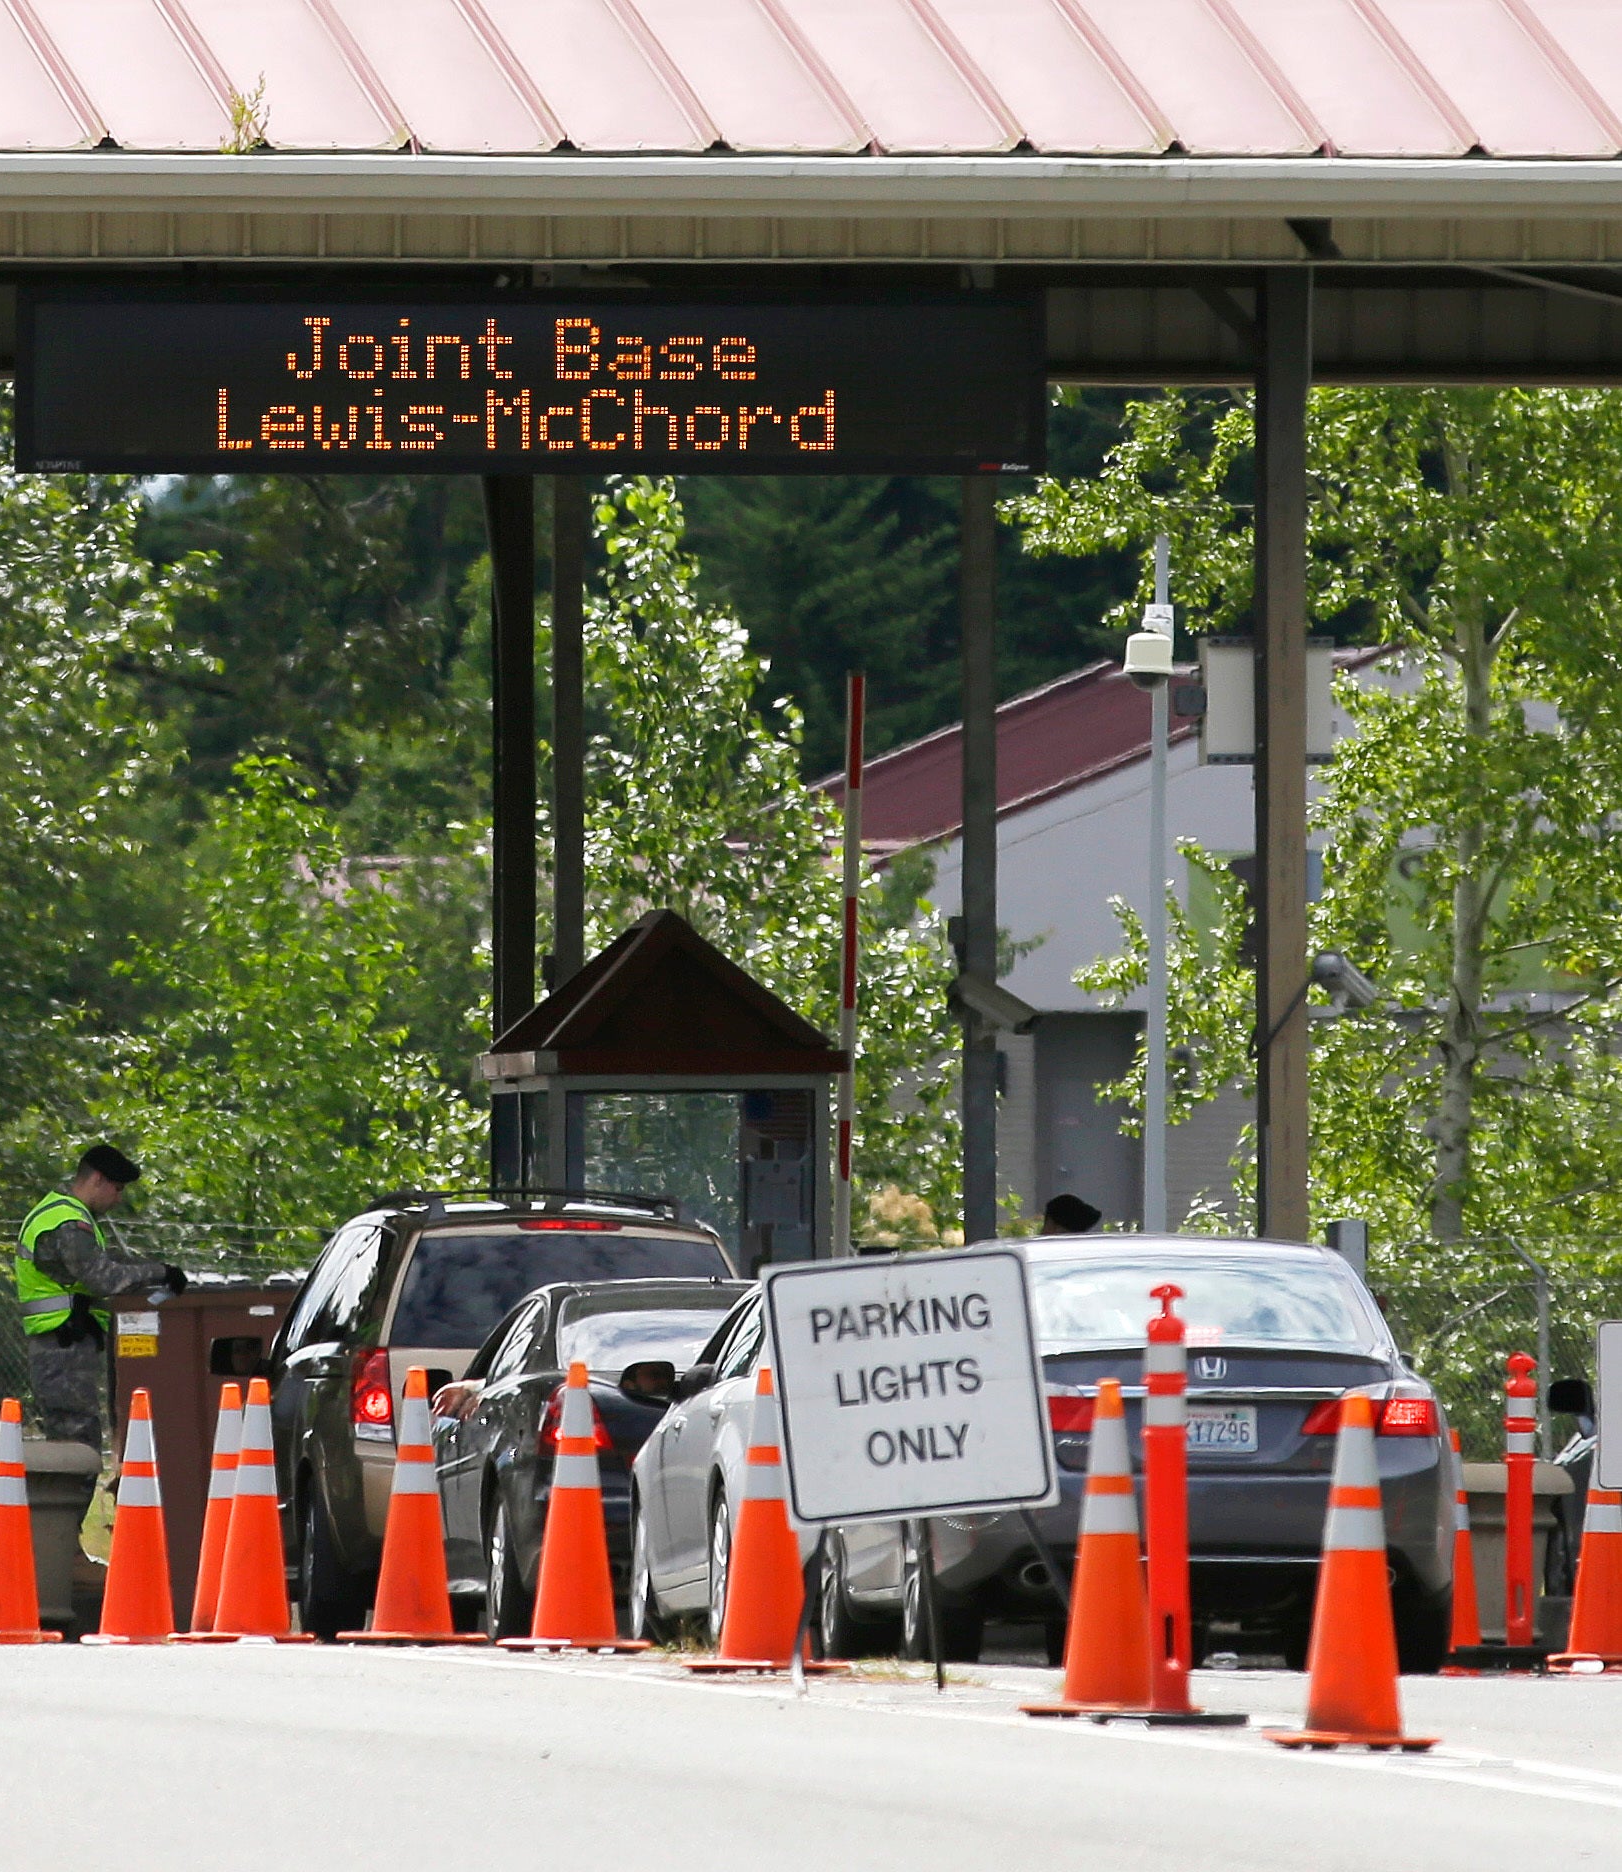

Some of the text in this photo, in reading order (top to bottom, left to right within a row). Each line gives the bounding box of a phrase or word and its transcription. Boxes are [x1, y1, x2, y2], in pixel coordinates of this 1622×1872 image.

[287, 317, 757, 380] Joint Base
[217, 388, 836, 450] Lewis-McChord
[810, 1293, 992, 1343] PARKING
[835, 1358, 983, 1407] LIGHTS
[867, 1424, 970, 1467] ONLY
